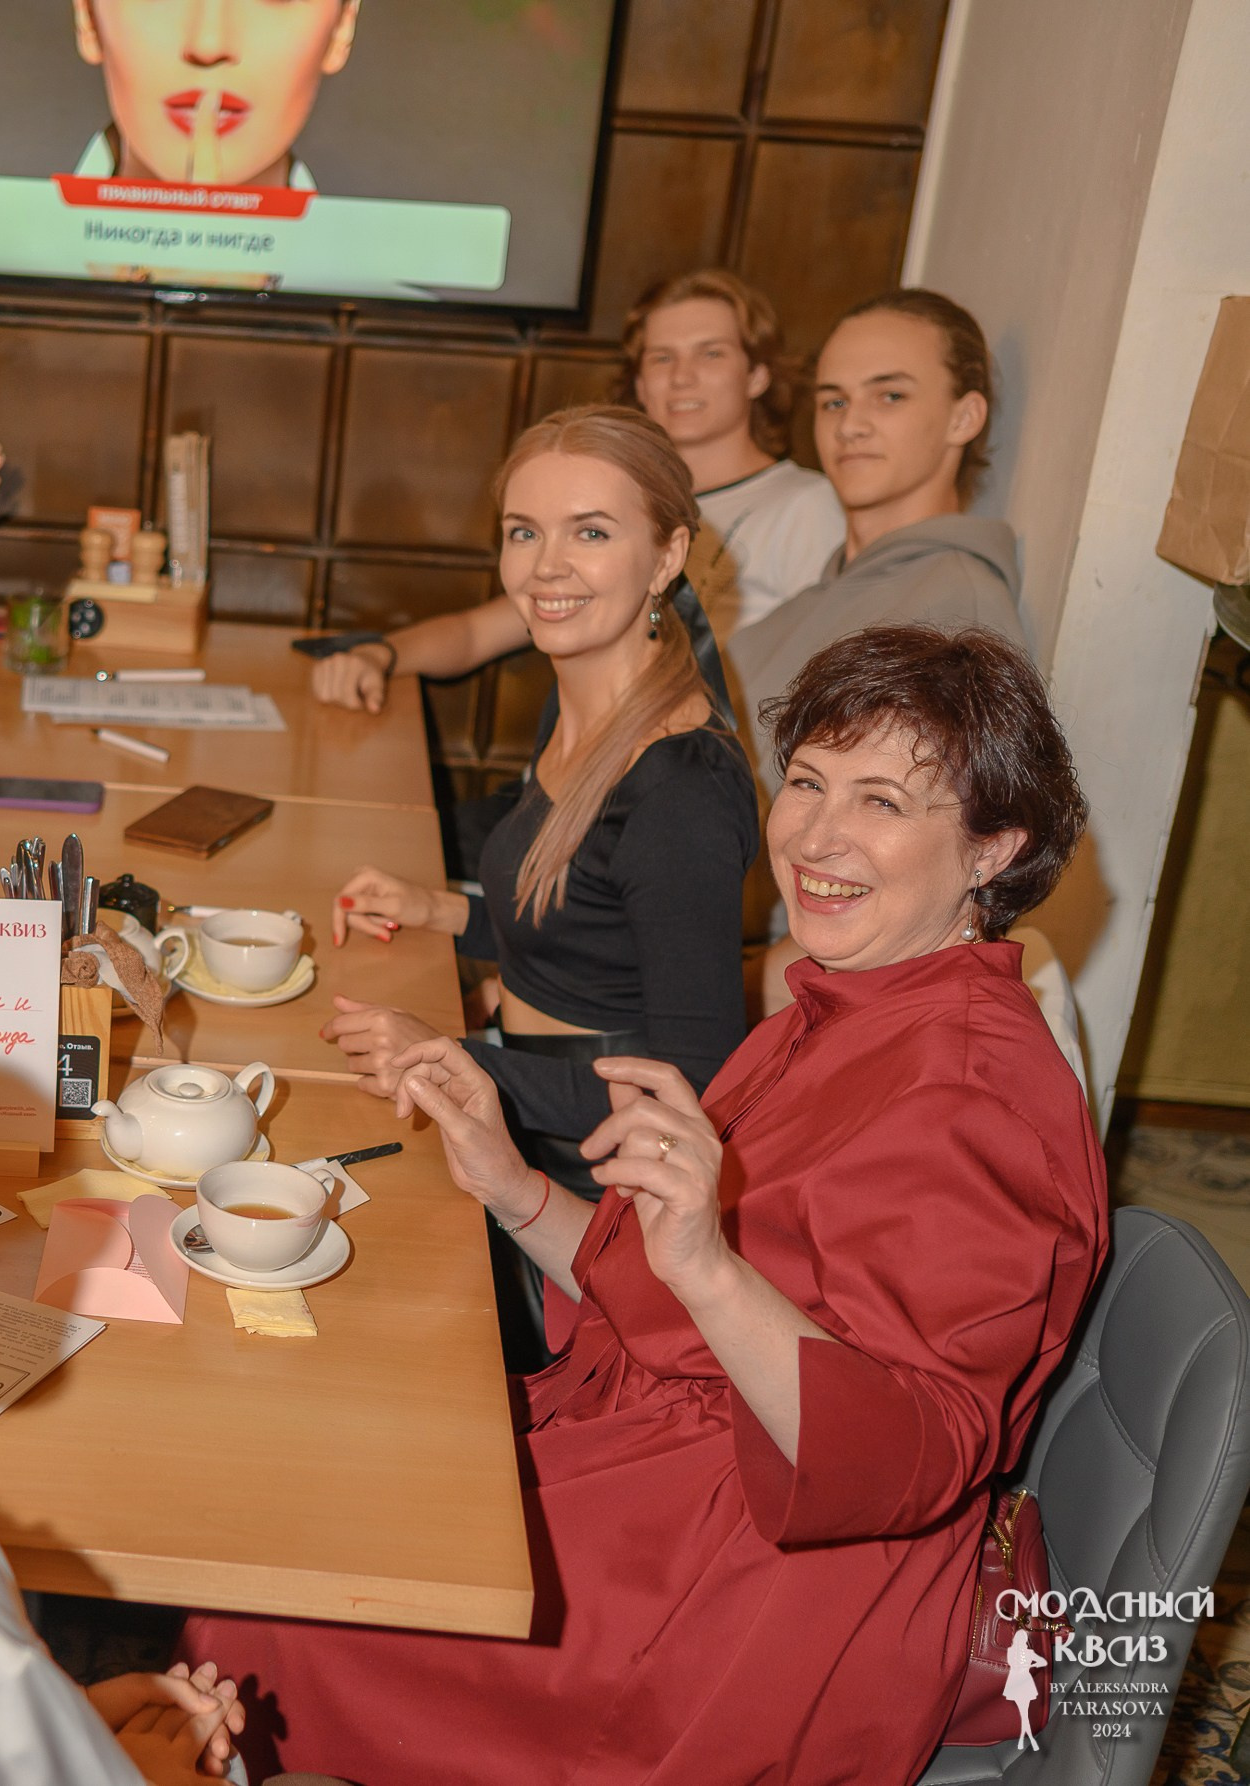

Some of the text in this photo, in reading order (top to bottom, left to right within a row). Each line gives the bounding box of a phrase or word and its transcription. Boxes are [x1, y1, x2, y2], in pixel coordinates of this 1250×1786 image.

[98, 185, 262, 210] ПРАВИЛЬНЫЙ ОТВЕТ
[85, 221, 275, 254] Никогда и нигде
[0, 922, 47, 939] КВИЗ
[14, 997, 32, 1011] и
[66, 1042, 94, 1051] Отзыв.
